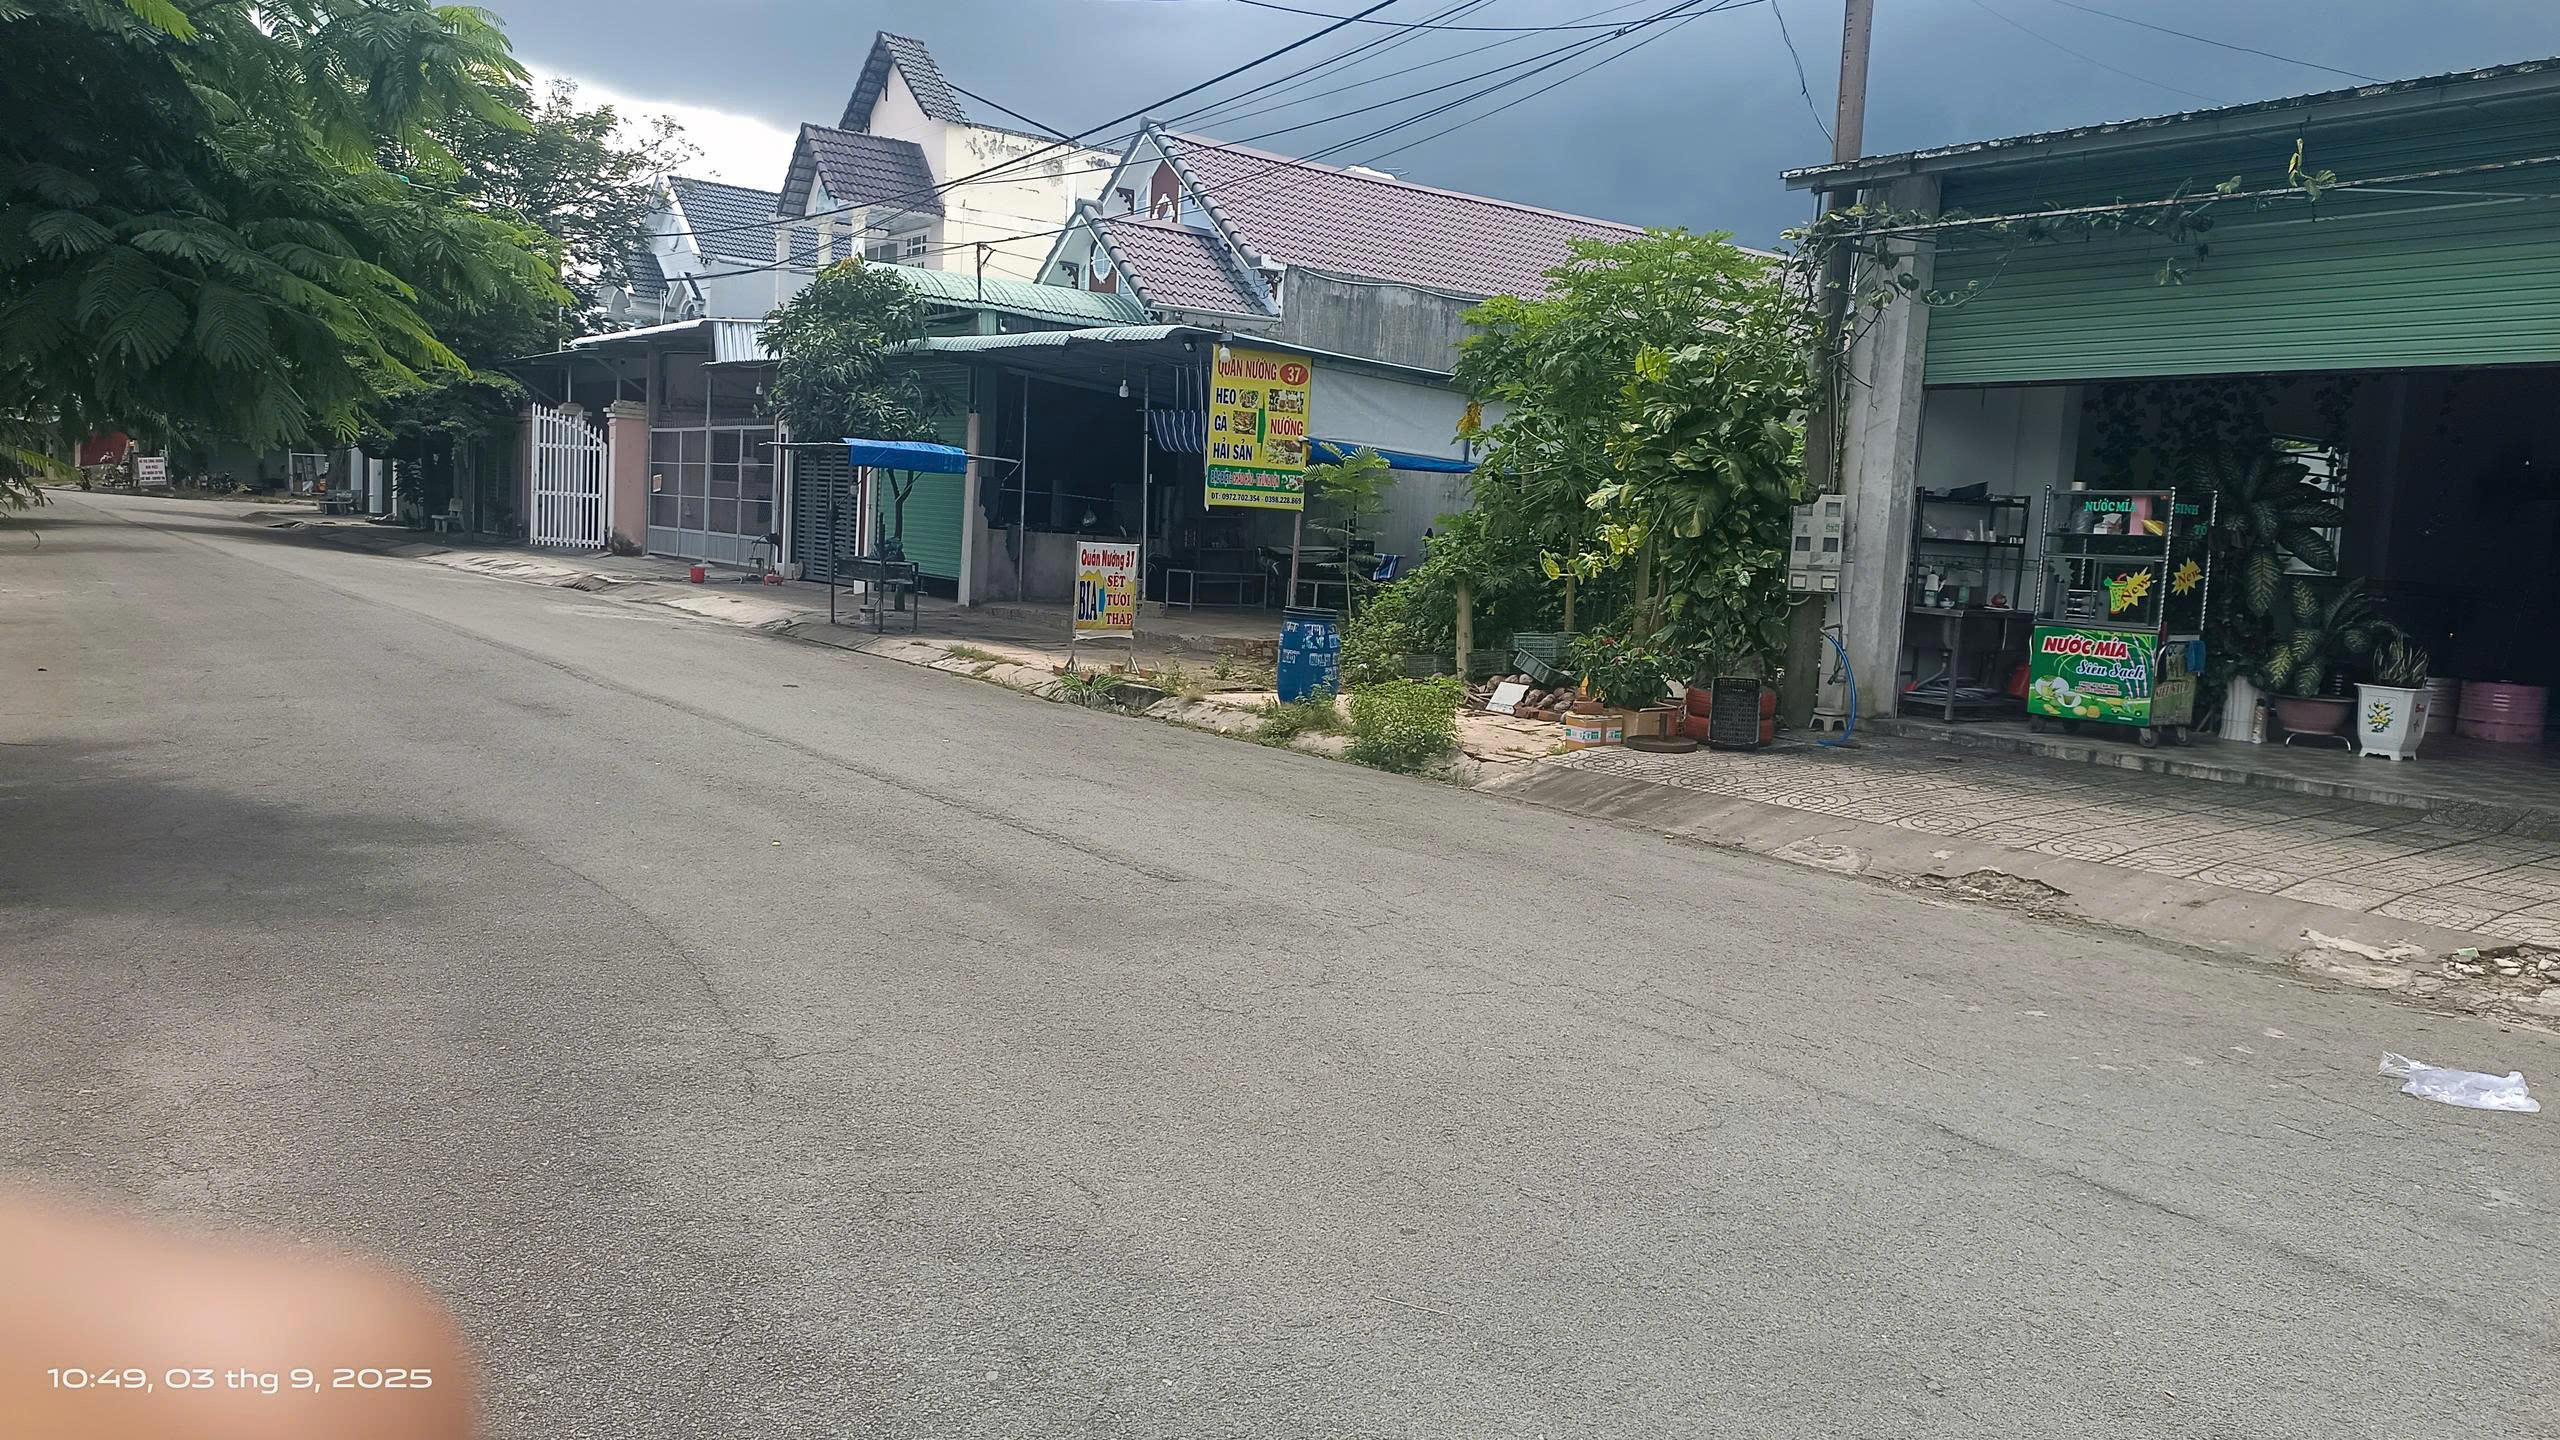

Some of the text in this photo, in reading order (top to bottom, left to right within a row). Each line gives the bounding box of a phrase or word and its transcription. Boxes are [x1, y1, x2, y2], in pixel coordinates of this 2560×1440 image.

[1218, 355, 1301, 382] QUÁN NƯỚNG 37
[1216, 387, 1236, 404] HEO
[1214, 411, 1227, 431] GÀ
[1270, 416, 1303, 436] NƯỚNG
[1213, 437, 1253, 461] HẢI SẢN
[2084, 498, 2137, 513] NƯỚC MÍA
[1081, 548, 1100, 566] Quán
[1101, 549, 1125, 570] Nướng
[1106, 571, 1126, 591] SỆT
[2121, 577, 2151, 600] New
[1078, 580, 1097, 620] BIA
[1106, 592, 1131, 606] TƯƠI
[2042, 634, 2128, 660] NƯỚC MÍA
[2076, 660, 2146, 680] Siêu Sạch
